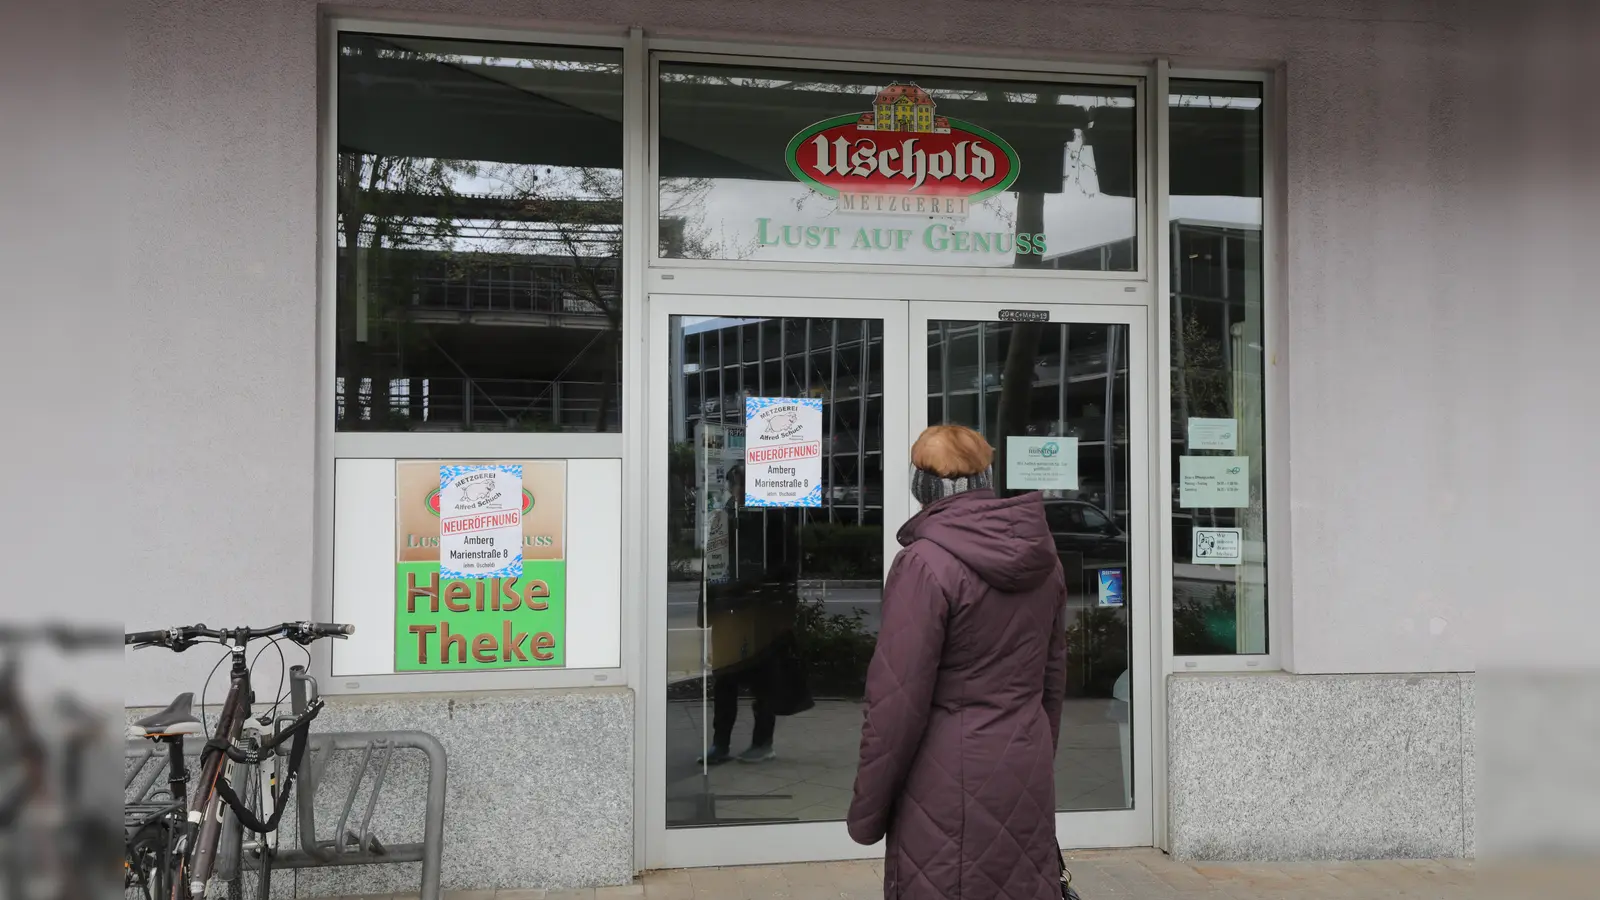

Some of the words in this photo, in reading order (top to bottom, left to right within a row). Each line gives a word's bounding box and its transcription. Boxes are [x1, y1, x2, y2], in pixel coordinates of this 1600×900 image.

[811, 134, 995, 191] Uschold
[842, 194, 965, 214] METZGEREI
[760, 405, 798, 419] METZGEREI
[780, 424, 803, 438] Schuch
[749, 444, 818, 462] NEUERÖFFNUNG
[767, 465, 796, 476] Amberg
[455, 472, 496, 488] METZGEREI
[754, 478, 802, 488] Marienstraße
[803, 478, 809, 488] 8
[477, 492, 502, 507] Schuch
[443, 512, 518, 533] NEUERÖFFNUNG
[407, 534, 440, 547] LUS
[463, 536, 495, 547] Amberg
[450, 549, 501, 559] Marienstraße
[503, 549, 509, 559] 8
[408, 620, 556, 664] Theke
